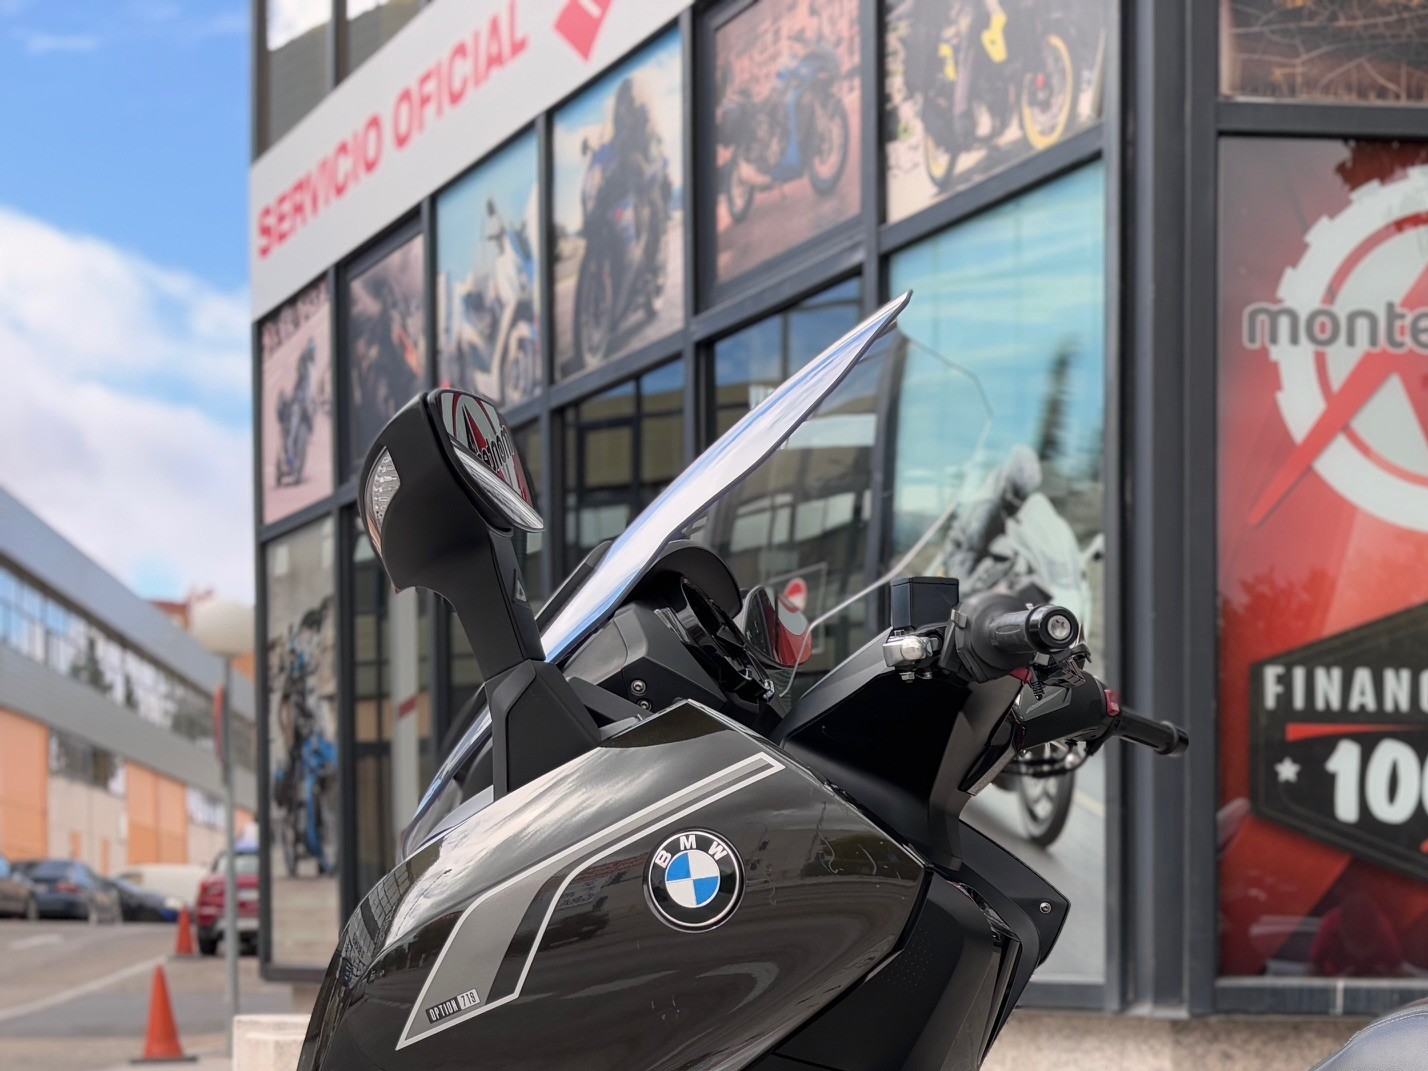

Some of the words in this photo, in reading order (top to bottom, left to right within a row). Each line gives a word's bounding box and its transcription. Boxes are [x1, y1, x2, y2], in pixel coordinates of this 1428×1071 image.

[257, 114, 382, 259] SERVICIO
[393, 0, 529, 149] OFICIAL
[654, 834, 729, 869] BMW
[429, 998, 459, 1021] OPTION
[460, 991, 477, 1007] 719
